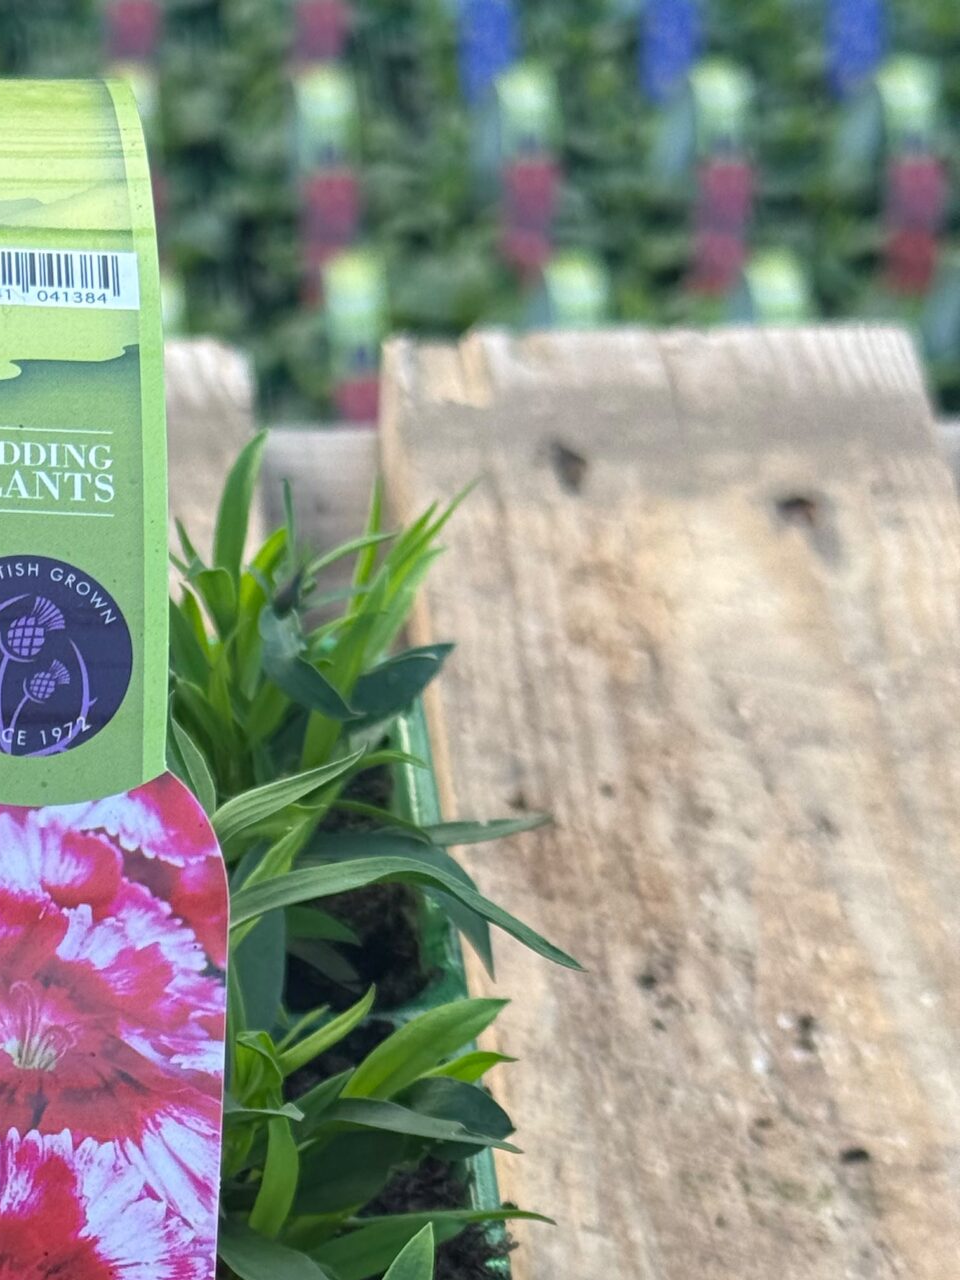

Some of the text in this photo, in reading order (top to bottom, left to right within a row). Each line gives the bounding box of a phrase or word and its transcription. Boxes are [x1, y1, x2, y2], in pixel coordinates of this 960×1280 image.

[37, 290, 107, 304] 041384
[50, 567, 117, 625] GROWN
[40, 716, 92, 745] 1972
